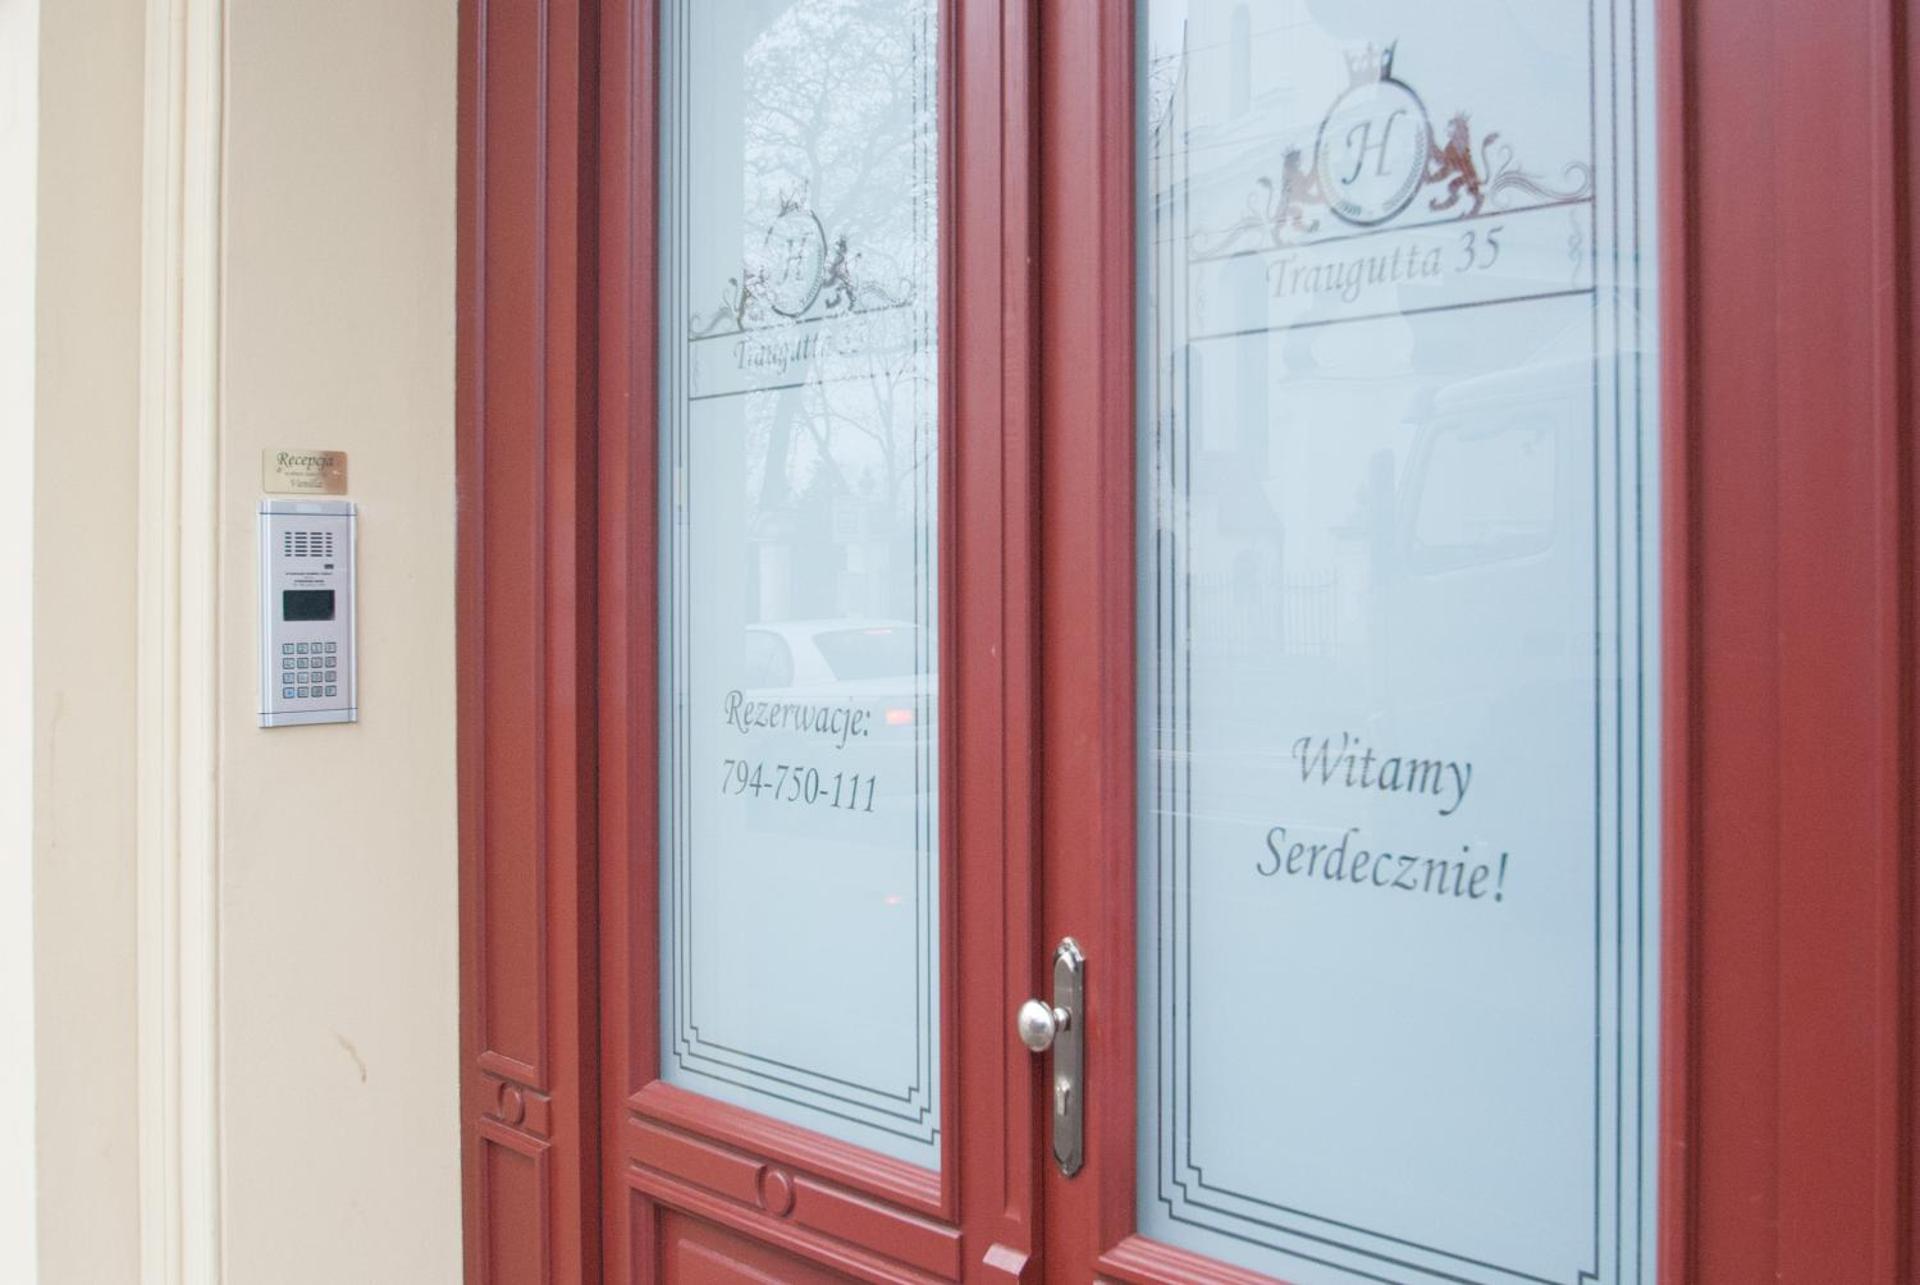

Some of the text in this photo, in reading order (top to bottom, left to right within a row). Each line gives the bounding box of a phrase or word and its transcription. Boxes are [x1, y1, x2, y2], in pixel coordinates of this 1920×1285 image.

[1341, 109, 1407, 184] H
[1266, 226, 1504, 302] Traugutta 35
[276, 451, 334, 472] Recepcja
[724, 689, 871, 750] Rezerwacje:
[722, 759, 877, 813] 794-750-111
[1291, 731, 1473, 817] Witamy
[1256, 826, 1509, 903] Serdecznie!
